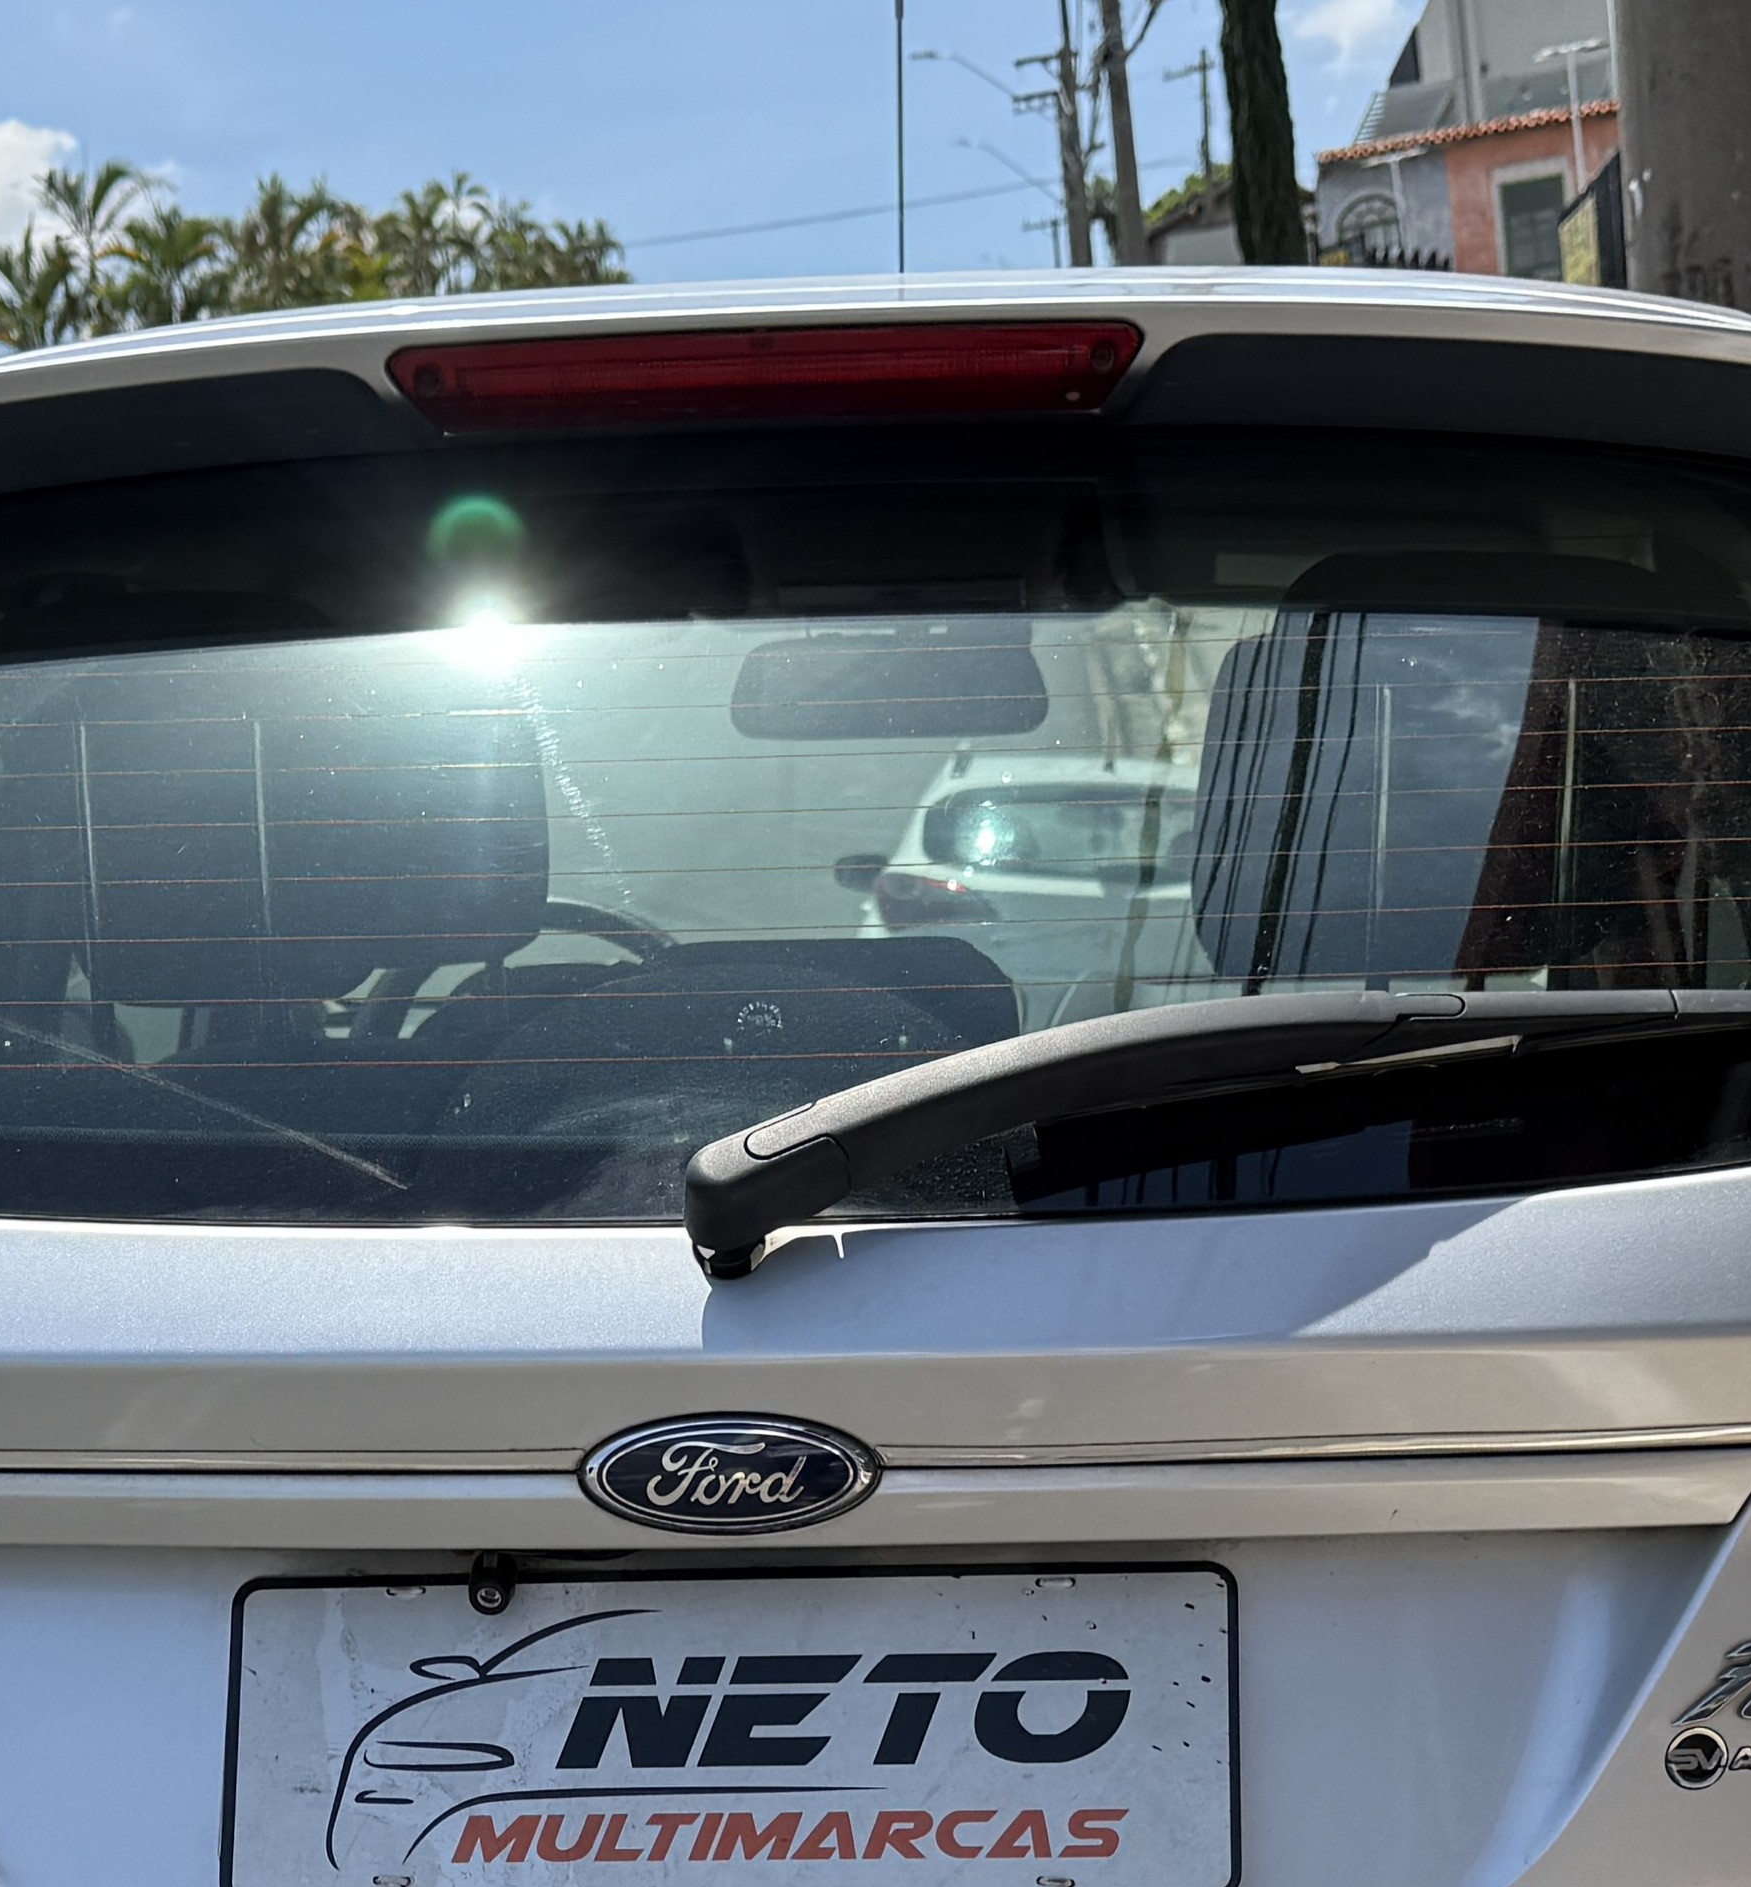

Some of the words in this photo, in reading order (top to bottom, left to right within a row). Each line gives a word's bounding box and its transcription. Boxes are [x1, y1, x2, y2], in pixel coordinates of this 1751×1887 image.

[646, 1441, 808, 1506] Ford
[554, 1651, 1131, 1769] NETO
[449, 1807, 1129, 1864] MULTIMARCAS
